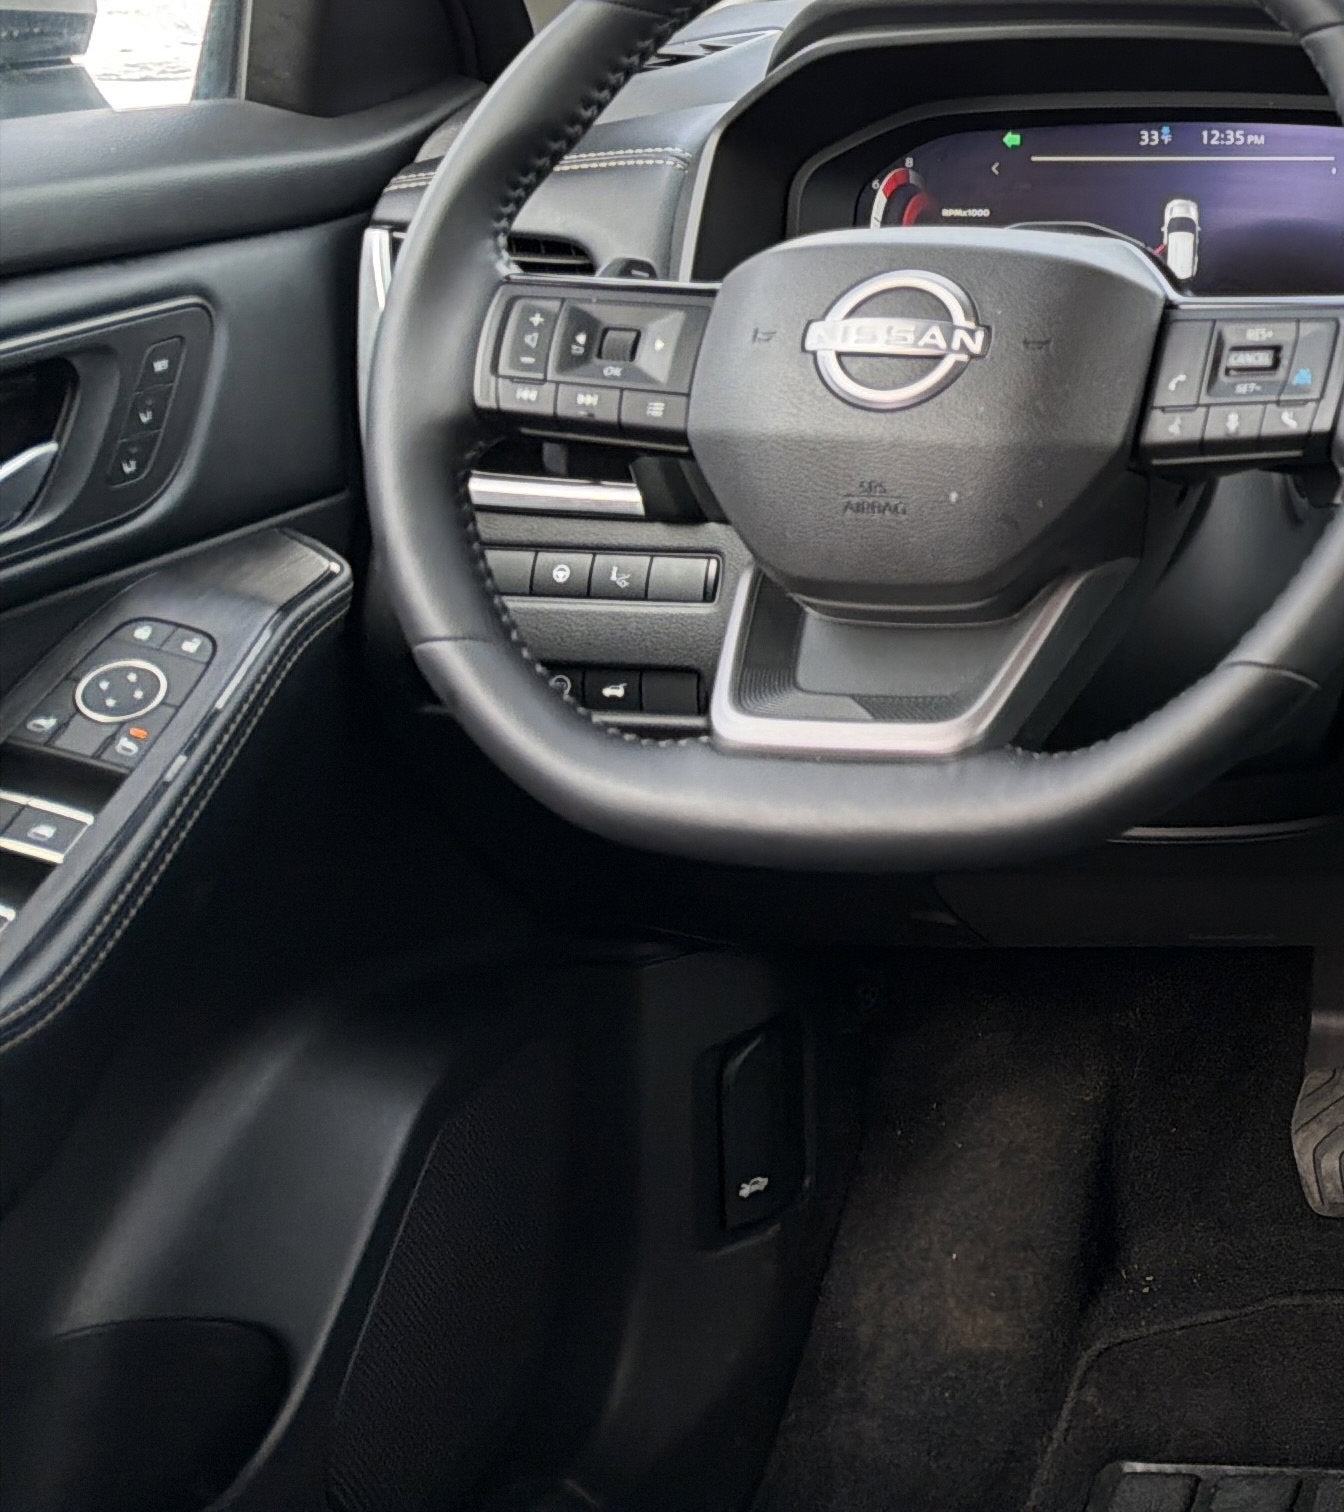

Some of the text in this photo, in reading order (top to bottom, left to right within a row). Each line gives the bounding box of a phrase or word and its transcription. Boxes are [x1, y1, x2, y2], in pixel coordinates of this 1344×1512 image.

[1202, 129, 1245, 146] 12:35
[1247, 134, 1265, 145] PM
[905, 157, 914, 168] 8
[872, 179, 880, 189] 6
[808, 322, 985, 355] NISSAN
[603, 366, 622, 377] OK
